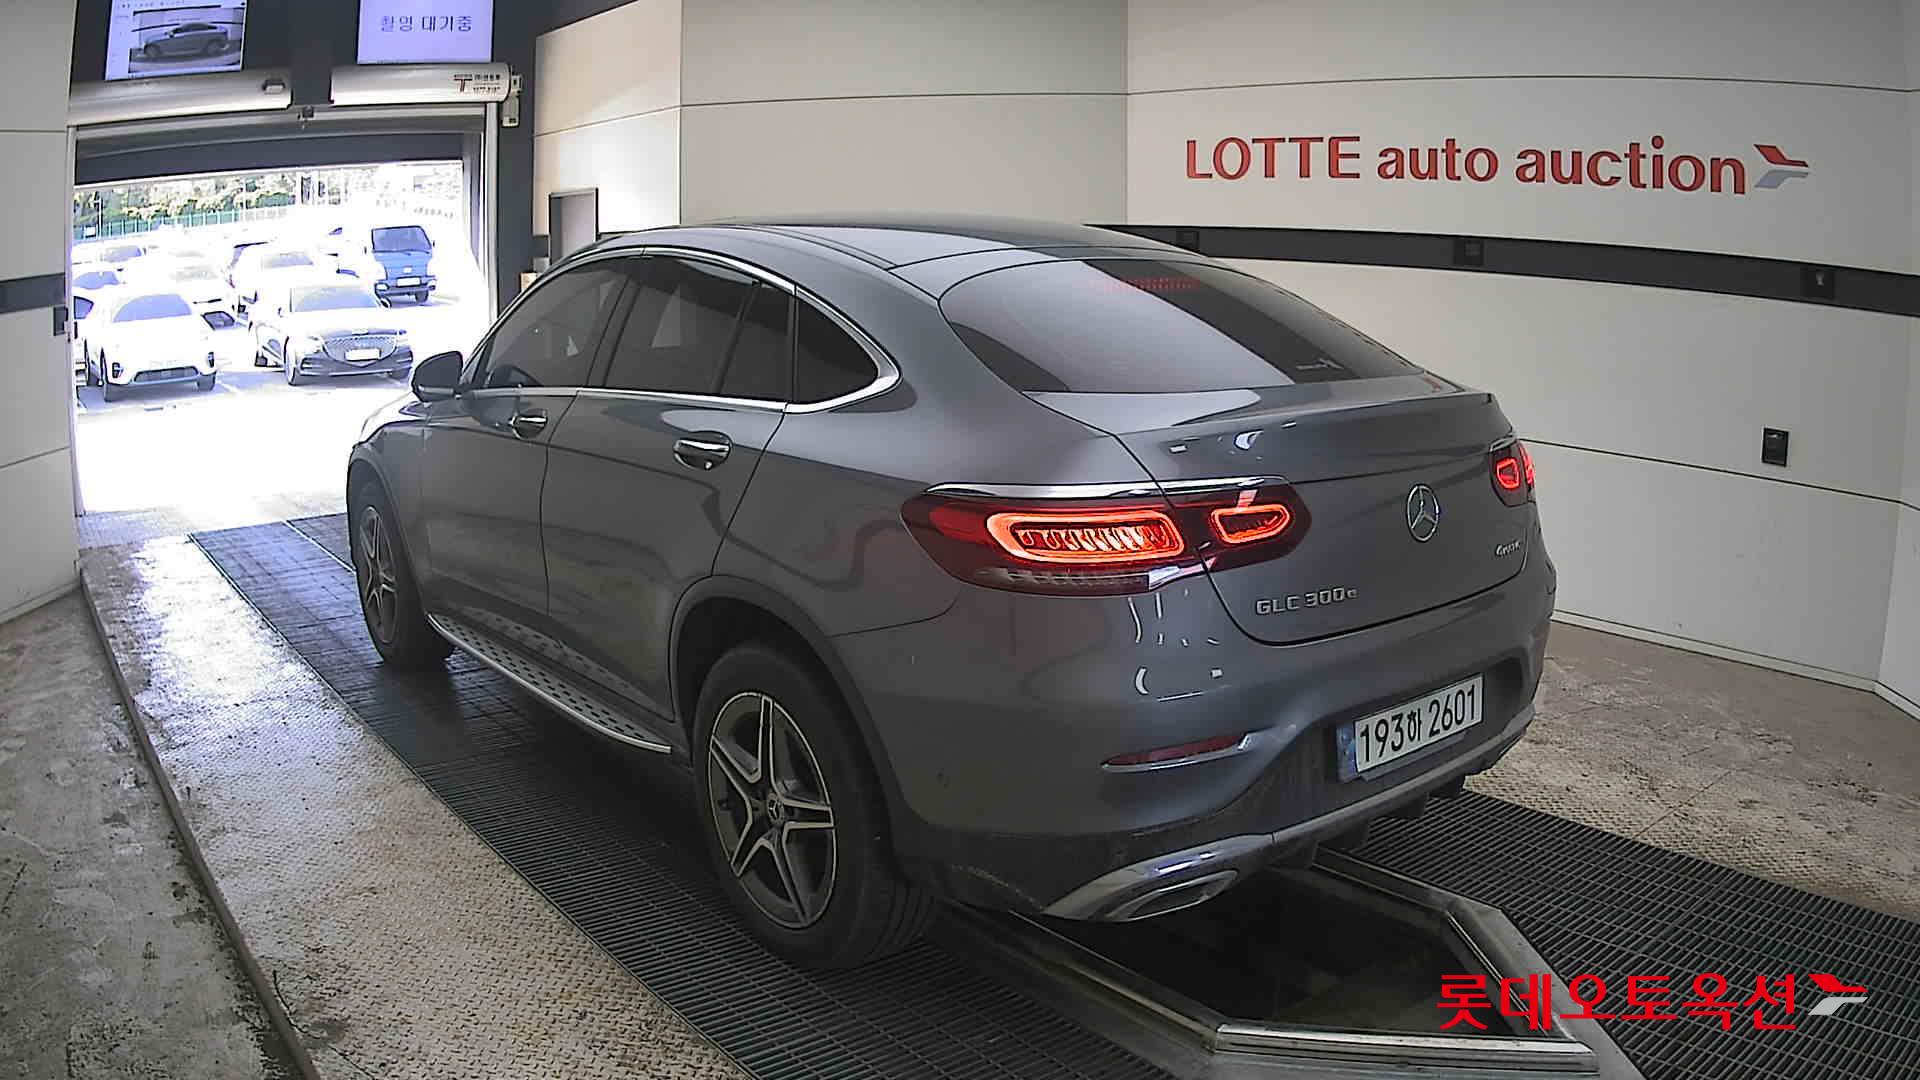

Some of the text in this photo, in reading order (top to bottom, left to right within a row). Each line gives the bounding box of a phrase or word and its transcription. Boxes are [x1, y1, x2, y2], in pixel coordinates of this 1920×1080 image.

[421, 15, 473, 32] 대기중
[1186, 135, 1747, 195] LOTTE auto auction
[1256, 596, 1301, 615] GLC
[1360, 683, 1476, 762] 193하 2601
